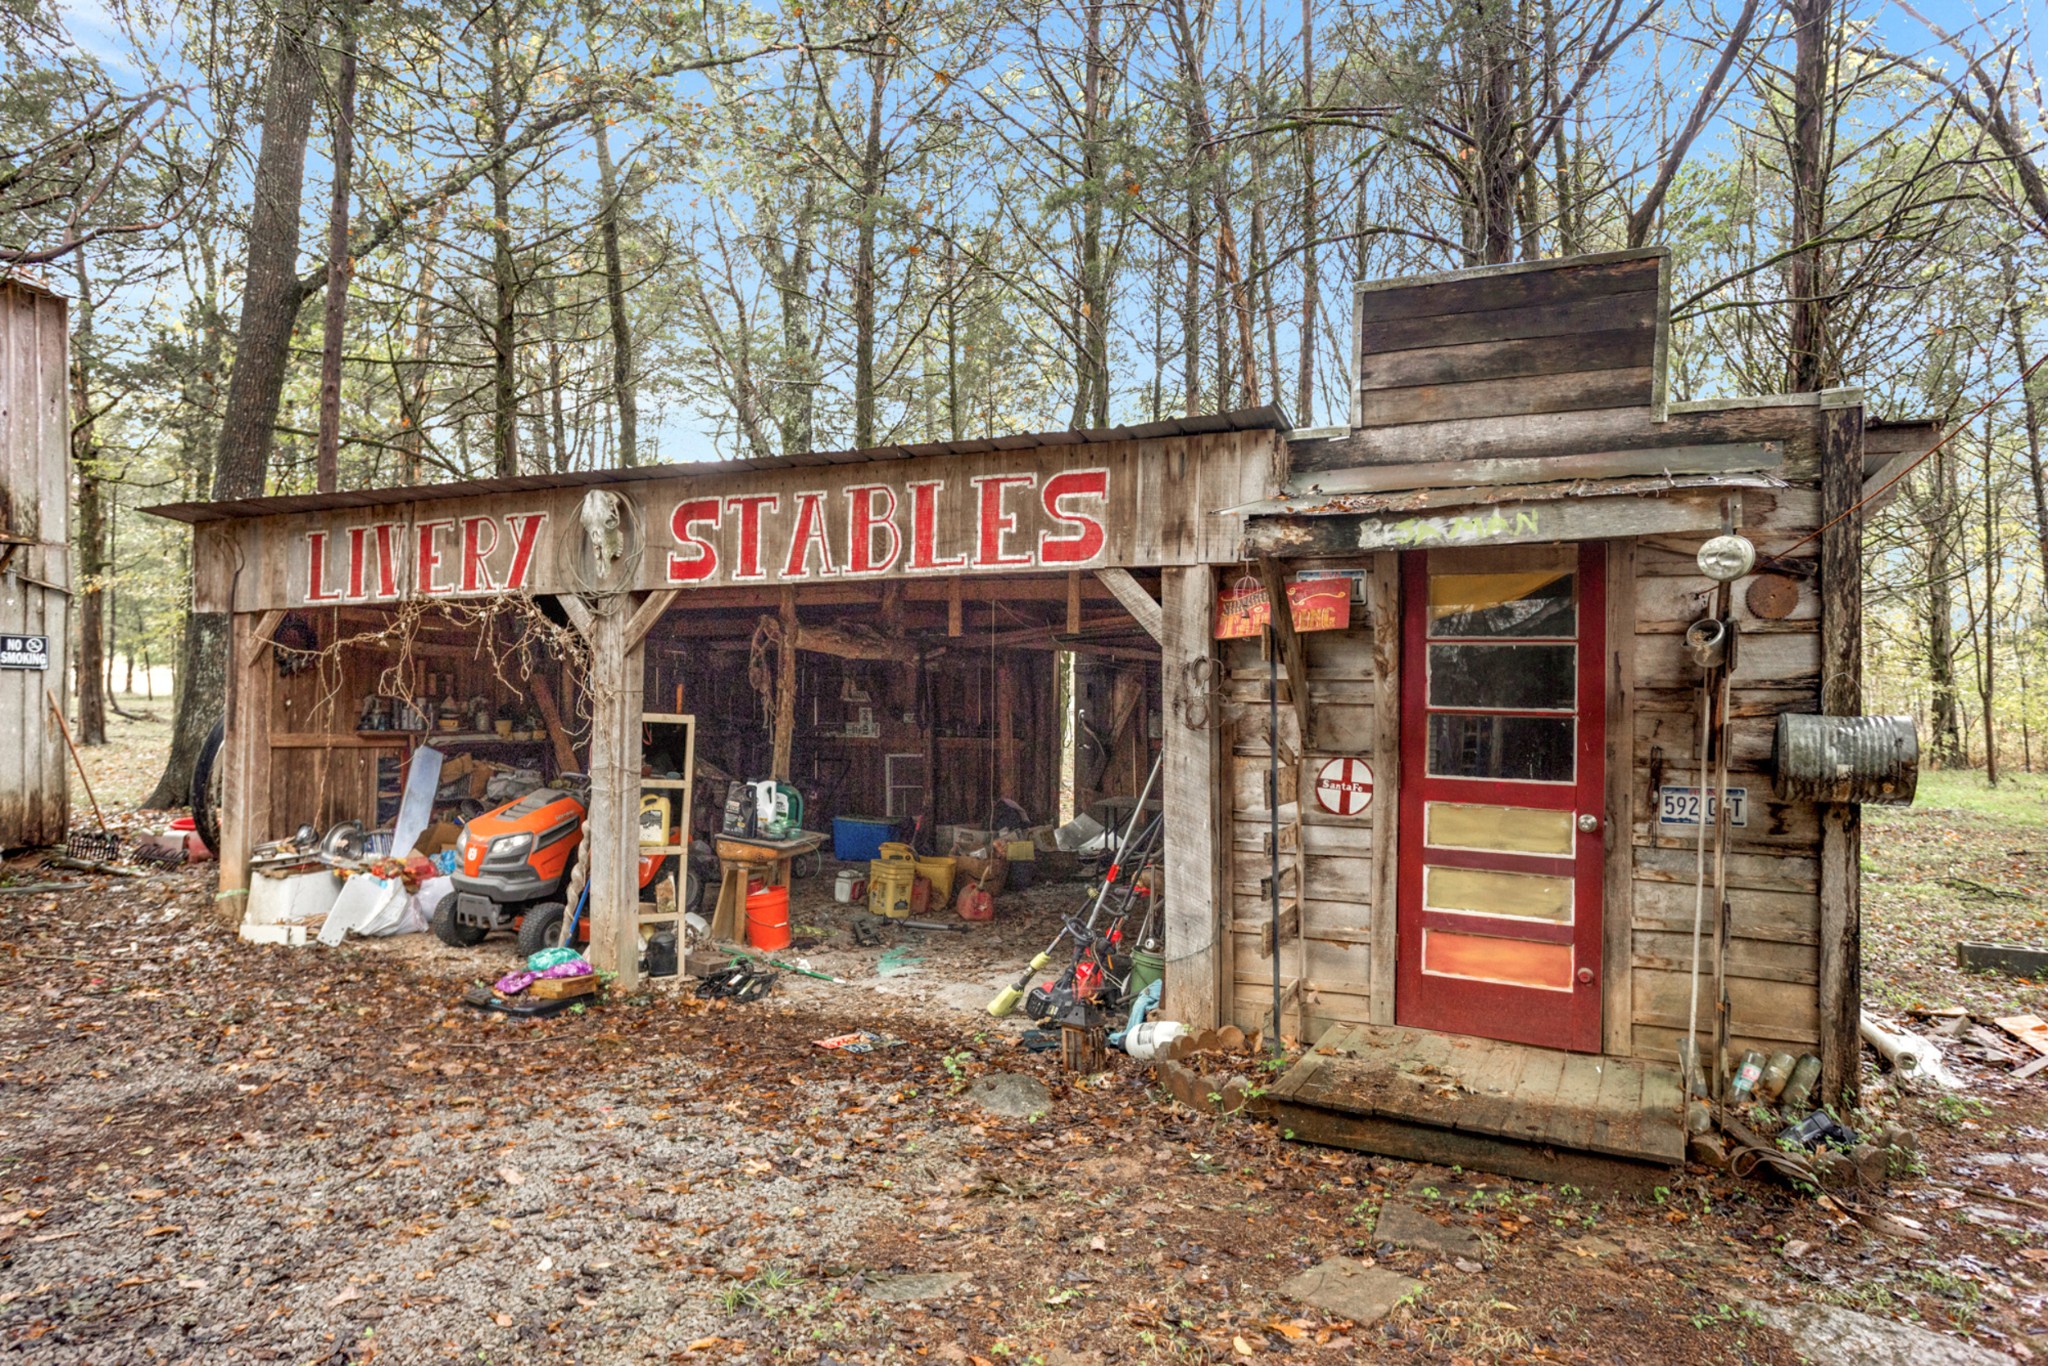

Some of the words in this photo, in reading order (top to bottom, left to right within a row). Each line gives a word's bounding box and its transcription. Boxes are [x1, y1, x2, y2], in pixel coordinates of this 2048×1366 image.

[304, 510, 549, 604] LIVERY
[666, 466, 1110, 584] STABLES
[7, 638, 22, 651] NO
[1, 651, 46, 665] SMOKING
[1322, 779, 1351, 791] Santa
[1352, 782, 1363, 793] Fe
[1665, 796, 1699, 816] 592
